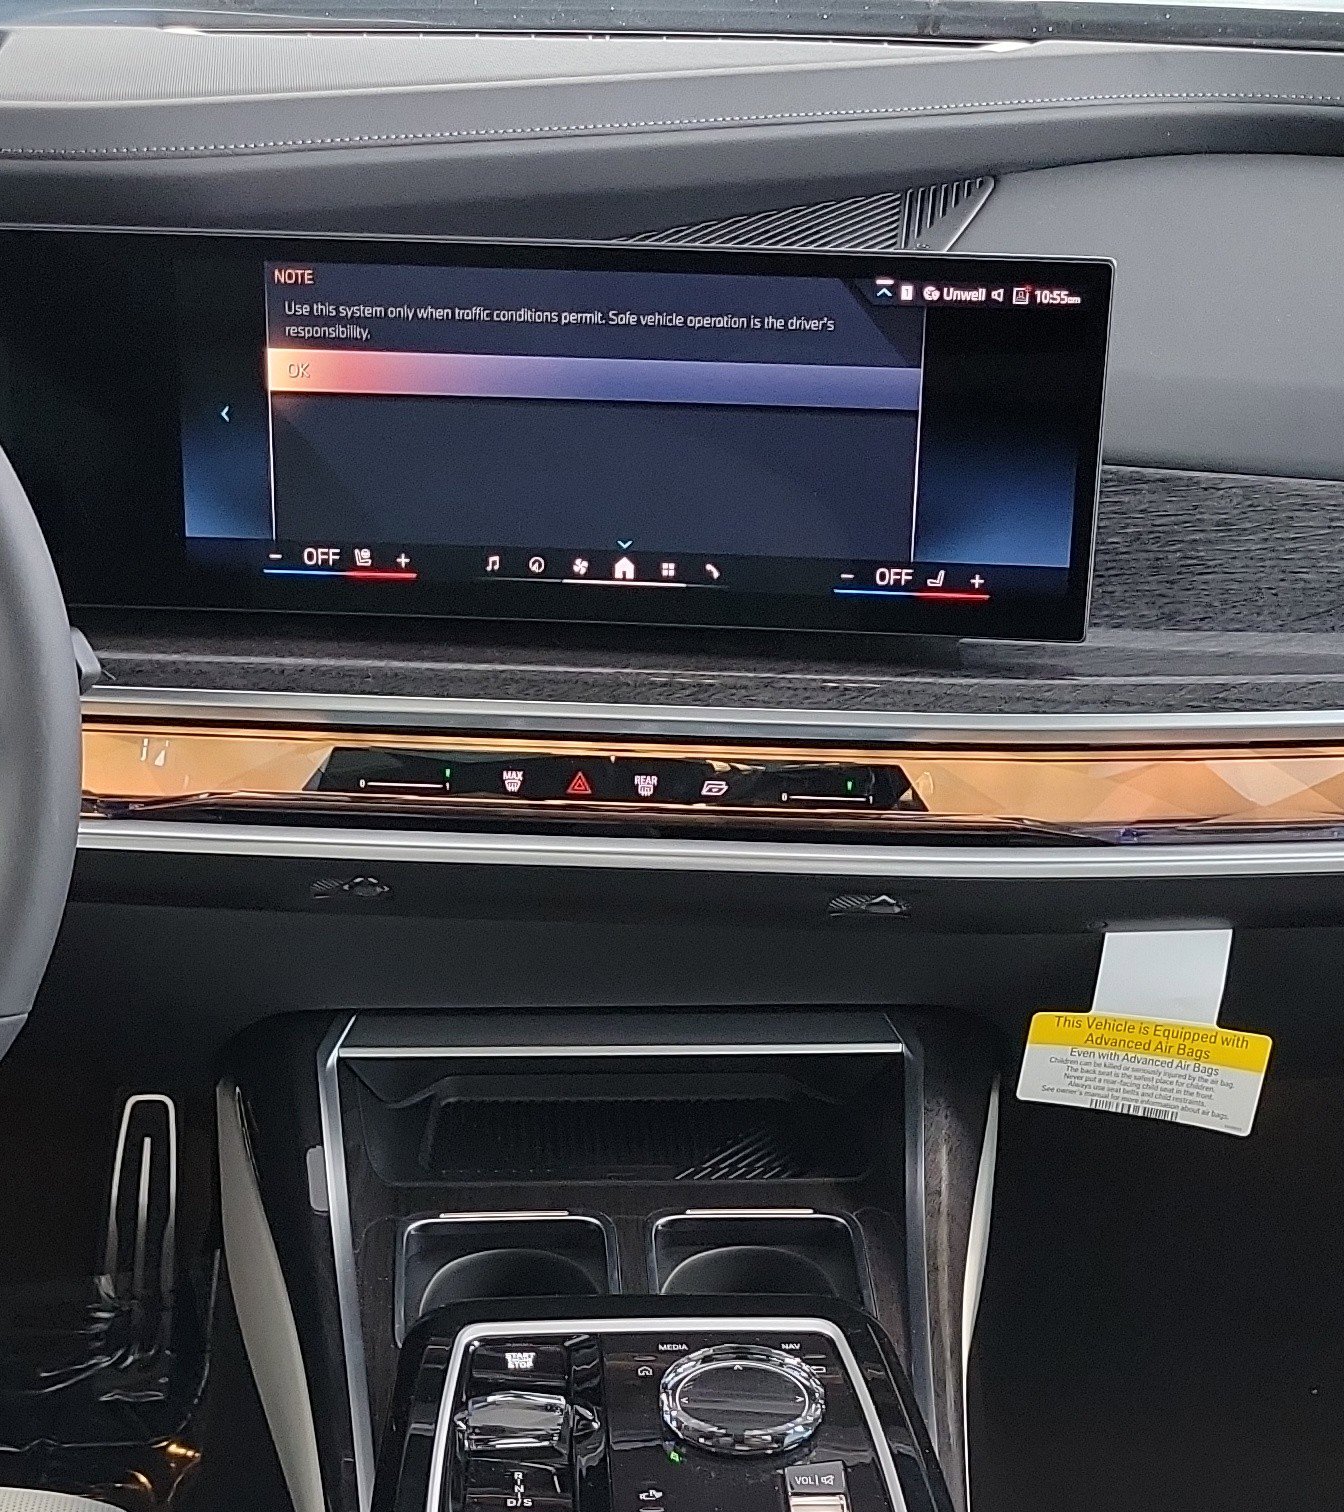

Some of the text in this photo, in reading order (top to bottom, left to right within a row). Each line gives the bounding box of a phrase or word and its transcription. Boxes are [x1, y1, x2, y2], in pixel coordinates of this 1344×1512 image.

[274, 269, 314, 285] NOTE
[943, 288, 986, 301] Unwell
[284, 301, 835, 331] Use this system only when traffic conditions permit. Safe vehicle operation is the driver's
[285, 324, 371, 341] responsibility.
[288, 363, 311, 379] OK
[304, 548, 341, 566] OFF
[875, 568, 914, 586] OFF
[503, 770, 524, 781] MAX
[634, 775, 658, 786] REAR
[1055, 1016, 1249, 1049] This Vehicle is Equipped with
[1084, 1033, 1211, 1060] Advanced Air Bags
[1070, 1047, 1220, 1077] Even with Advanced Air Bags
[1067, 1065, 1079, 1073] The
[1080, 1067, 1096, 1075] back
[1121, 1072, 1132, 1080] the
[1188, 1074, 1196, 1082] by
[1042, 1084, 1055, 1092] See
[1064, 1072, 1084, 1081] Never
[1183, 1089, 1195, 1097] the
[658, 1343, 689, 1351] MEDIA
[505, 1352, 536, 1360] START
[508, 1360, 534, 1369] STOP
[514, 1471, 523, 1480] R
[794, 1475, 815, 1485] VOL
[514, 1484, 525, 1493] N
